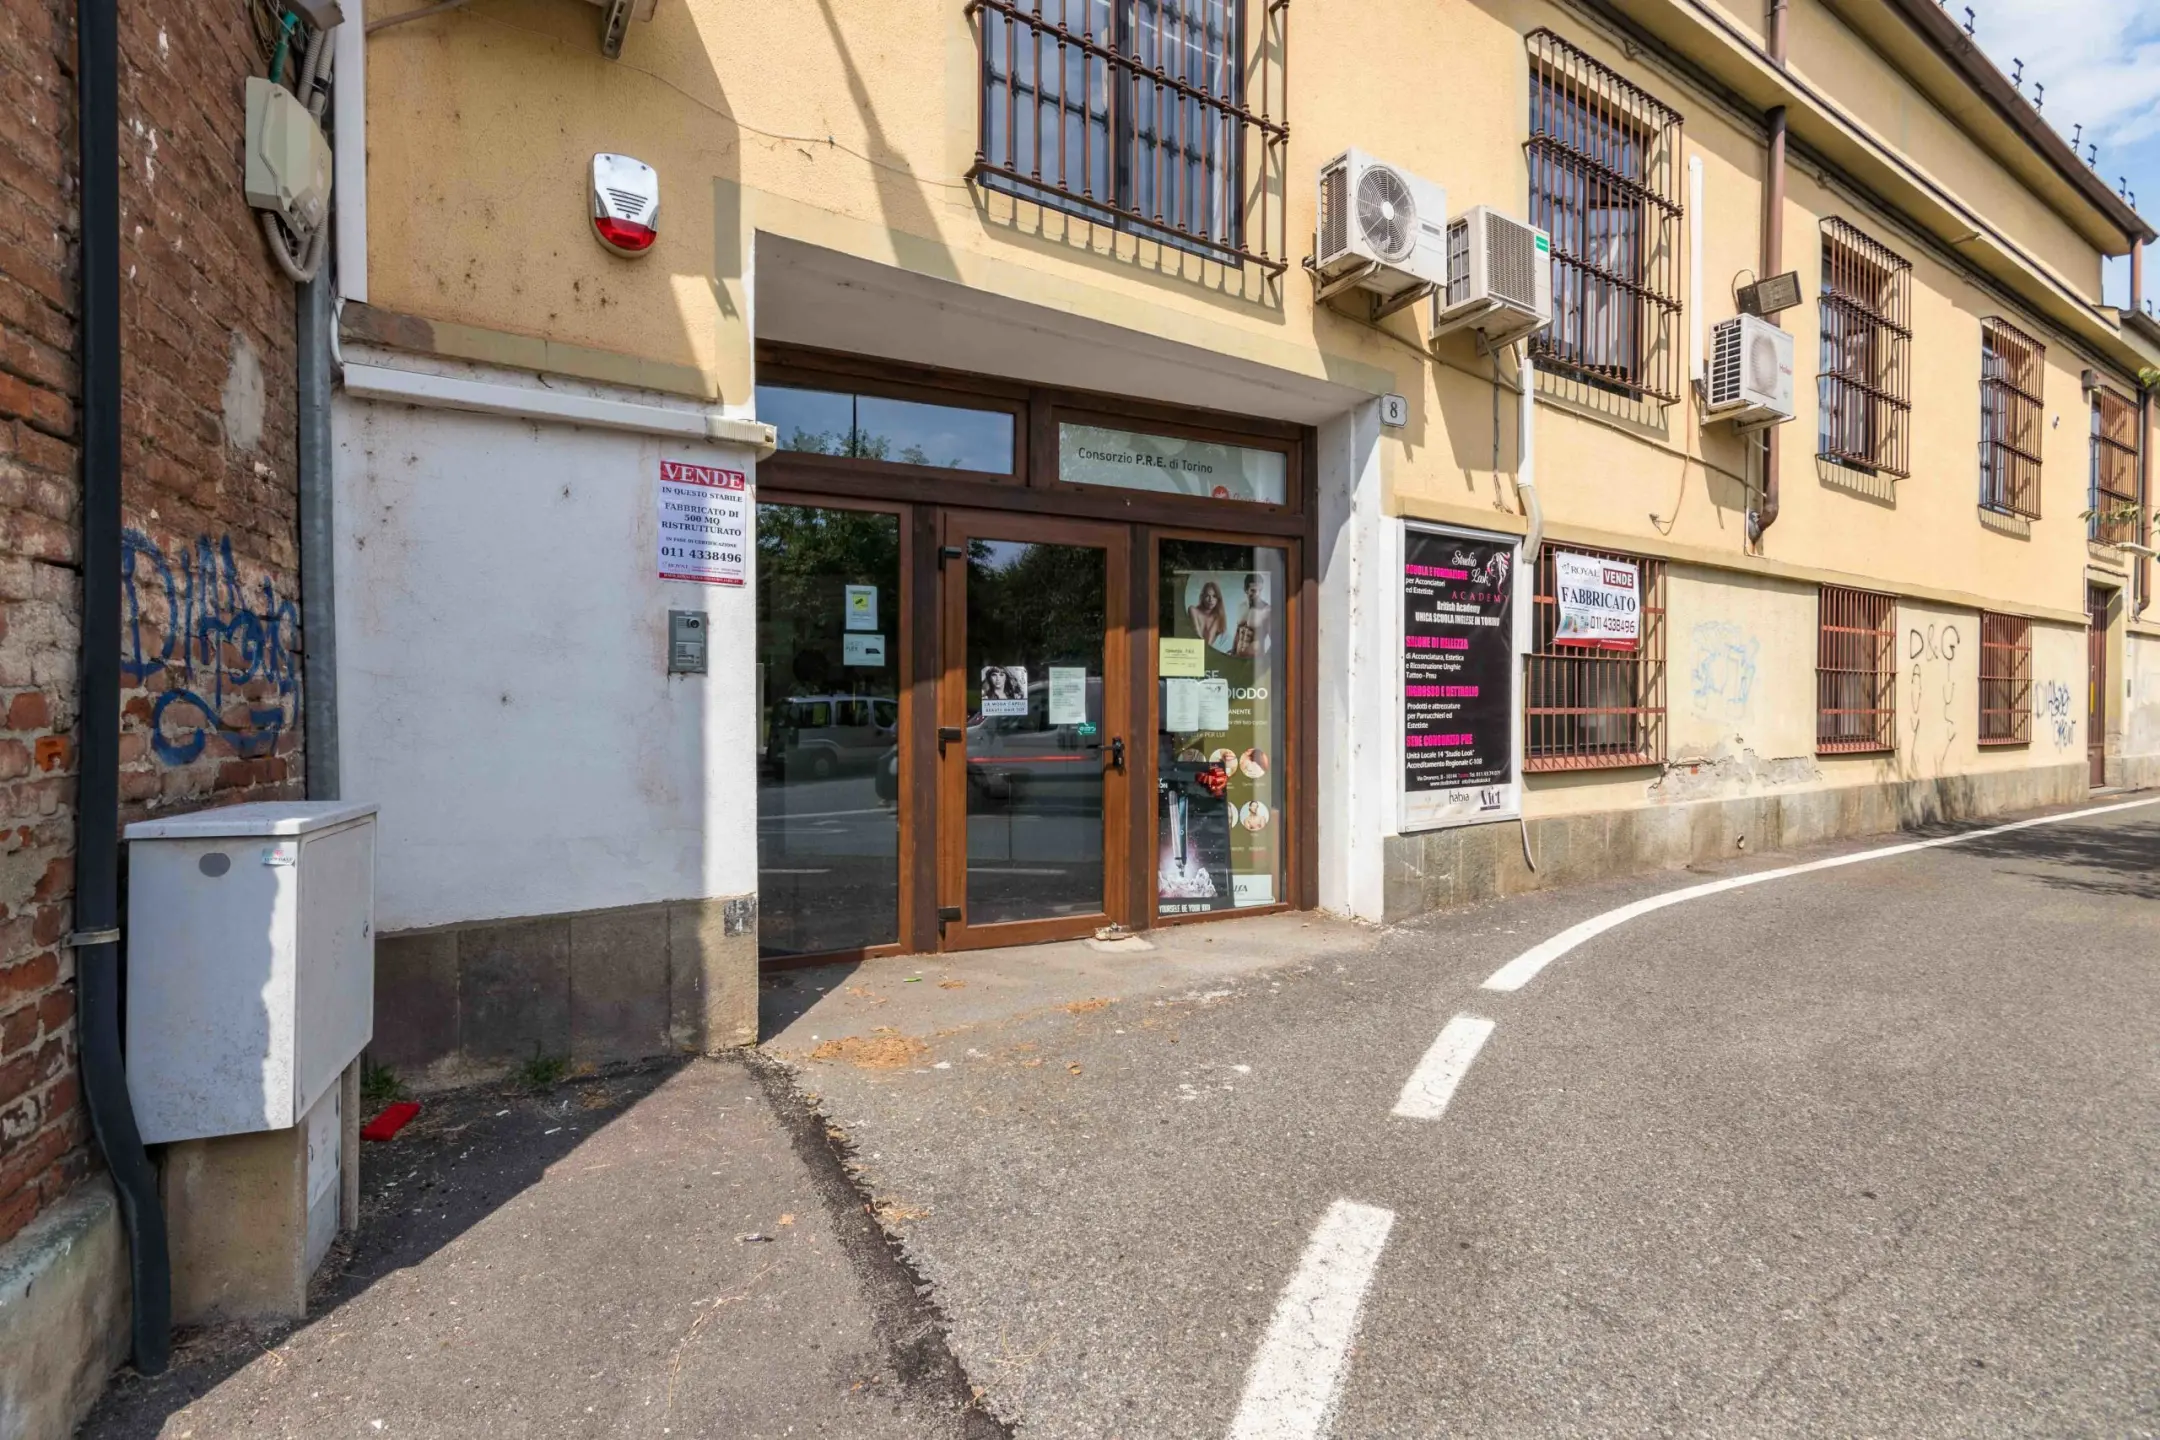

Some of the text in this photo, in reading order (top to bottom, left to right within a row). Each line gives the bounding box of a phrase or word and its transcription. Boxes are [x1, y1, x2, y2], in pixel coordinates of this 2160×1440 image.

[1389, 401, 1398, 419] 8
[1078, 446, 1213, 474] Consorzio P.R.E. di Torino
[664, 463, 742, 489] VENDE
[674, 487, 707, 498] QUESTO
[710, 493, 743, 503] STABILE
[665, 502, 739, 518] FABBRICATO DI
[684, 514, 720, 526] 500 MQ
[662, 520, 742, 537] RISTRUTTURATO
[661, 546, 742, 563] 011 4338496
[1452, 550, 1477, 567] Studio
[1471, 568, 1491, 586] Look
[1570, 565, 1600, 577] ROYAL
[1604, 570, 1633, 587] VENDE
[1415, 578, 1445, 587] Acconciatori
[1452, 590, 1510, 603] ACADEMY
[1561, 586, 1636, 612] FABBRICATO
[1437, 601, 1481, 614] British Academy
[1415, 611, 1500, 626] UNICA SCUOLA INGLESE IN TORINO
[1590, 616, 1635, 634] 011 4338496
[1411, 653, 1445, 661] Acconciatura,
[1410, 662, 1442, 670] Ricostruzione
[1443, 664, 1461, 672] Unghie
[1421, 751, 1436, 759] Locale
[1407, 760, 1445, 769] Accreditamento
[1446, 759, 1468, 768] Regionale
[1449, 790, 1470, 804] habia
